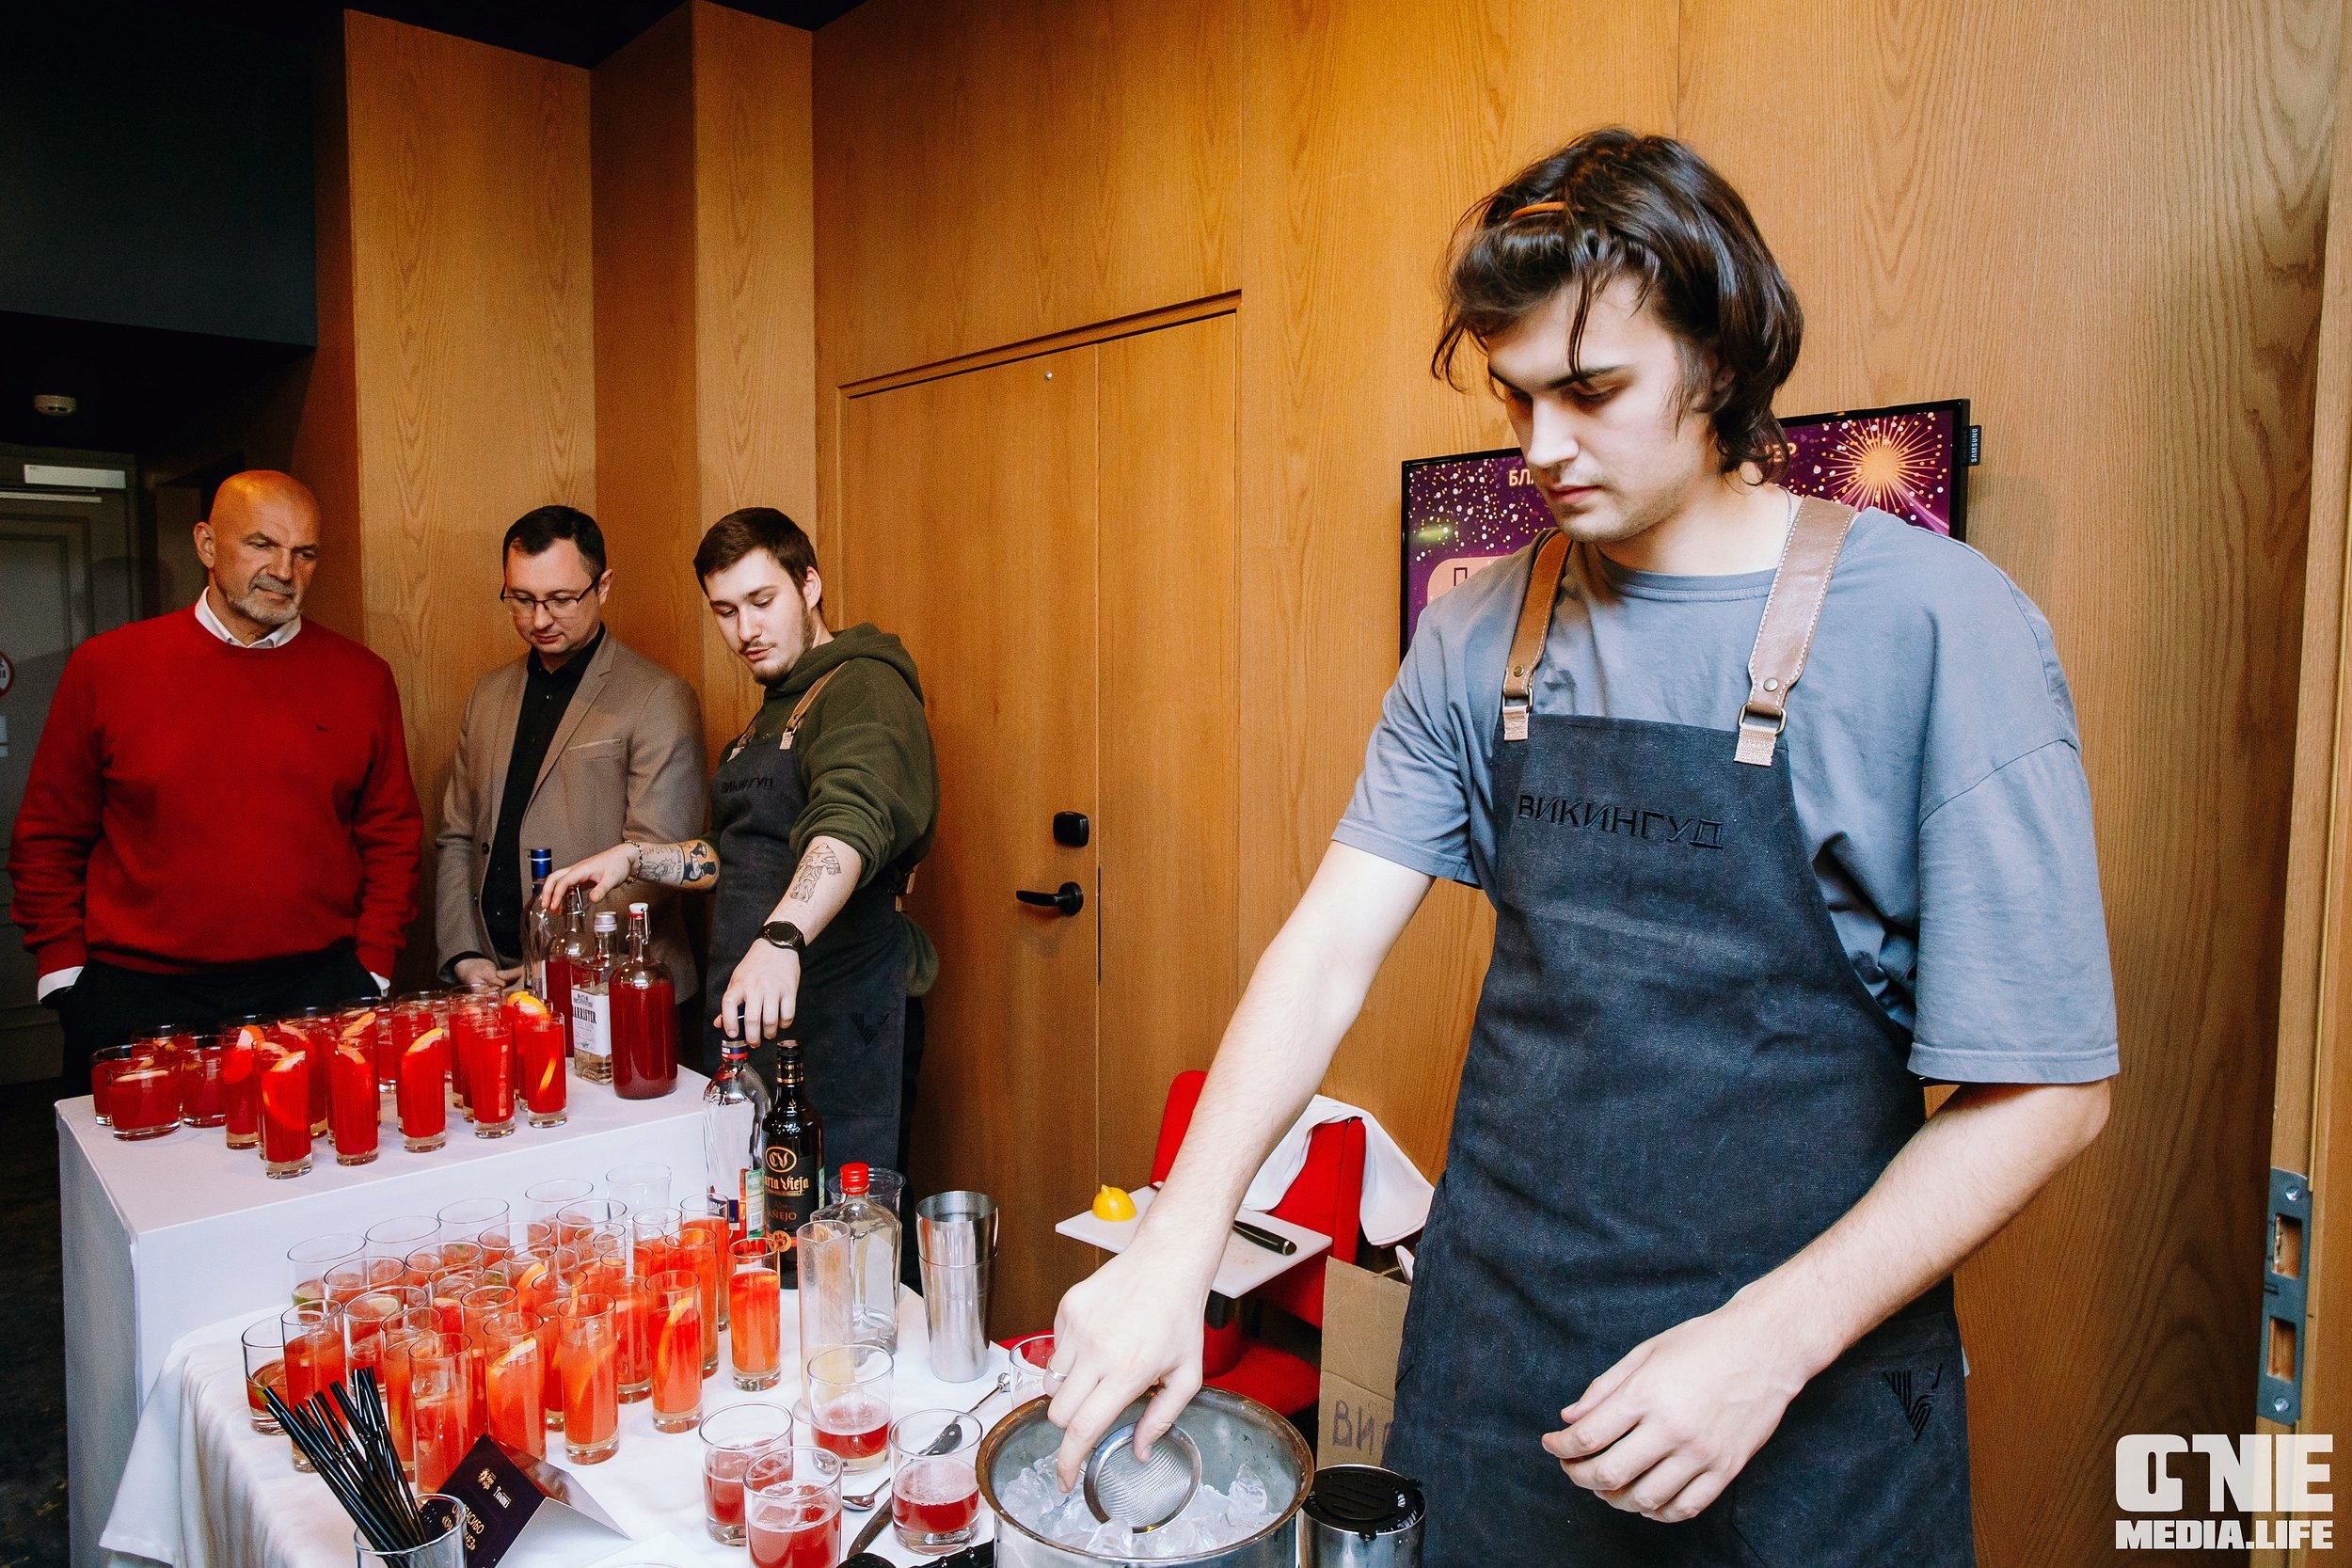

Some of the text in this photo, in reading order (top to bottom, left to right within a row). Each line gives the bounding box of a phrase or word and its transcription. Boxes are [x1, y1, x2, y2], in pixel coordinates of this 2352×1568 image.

[1508, 468, 1534, 486] БЛ
[1518, 795, 1724, 849] ВИКИНГУД
[572, 1006, 597, 1024] ARRISTER
[780, 1175, 809, 1196] Vieja
